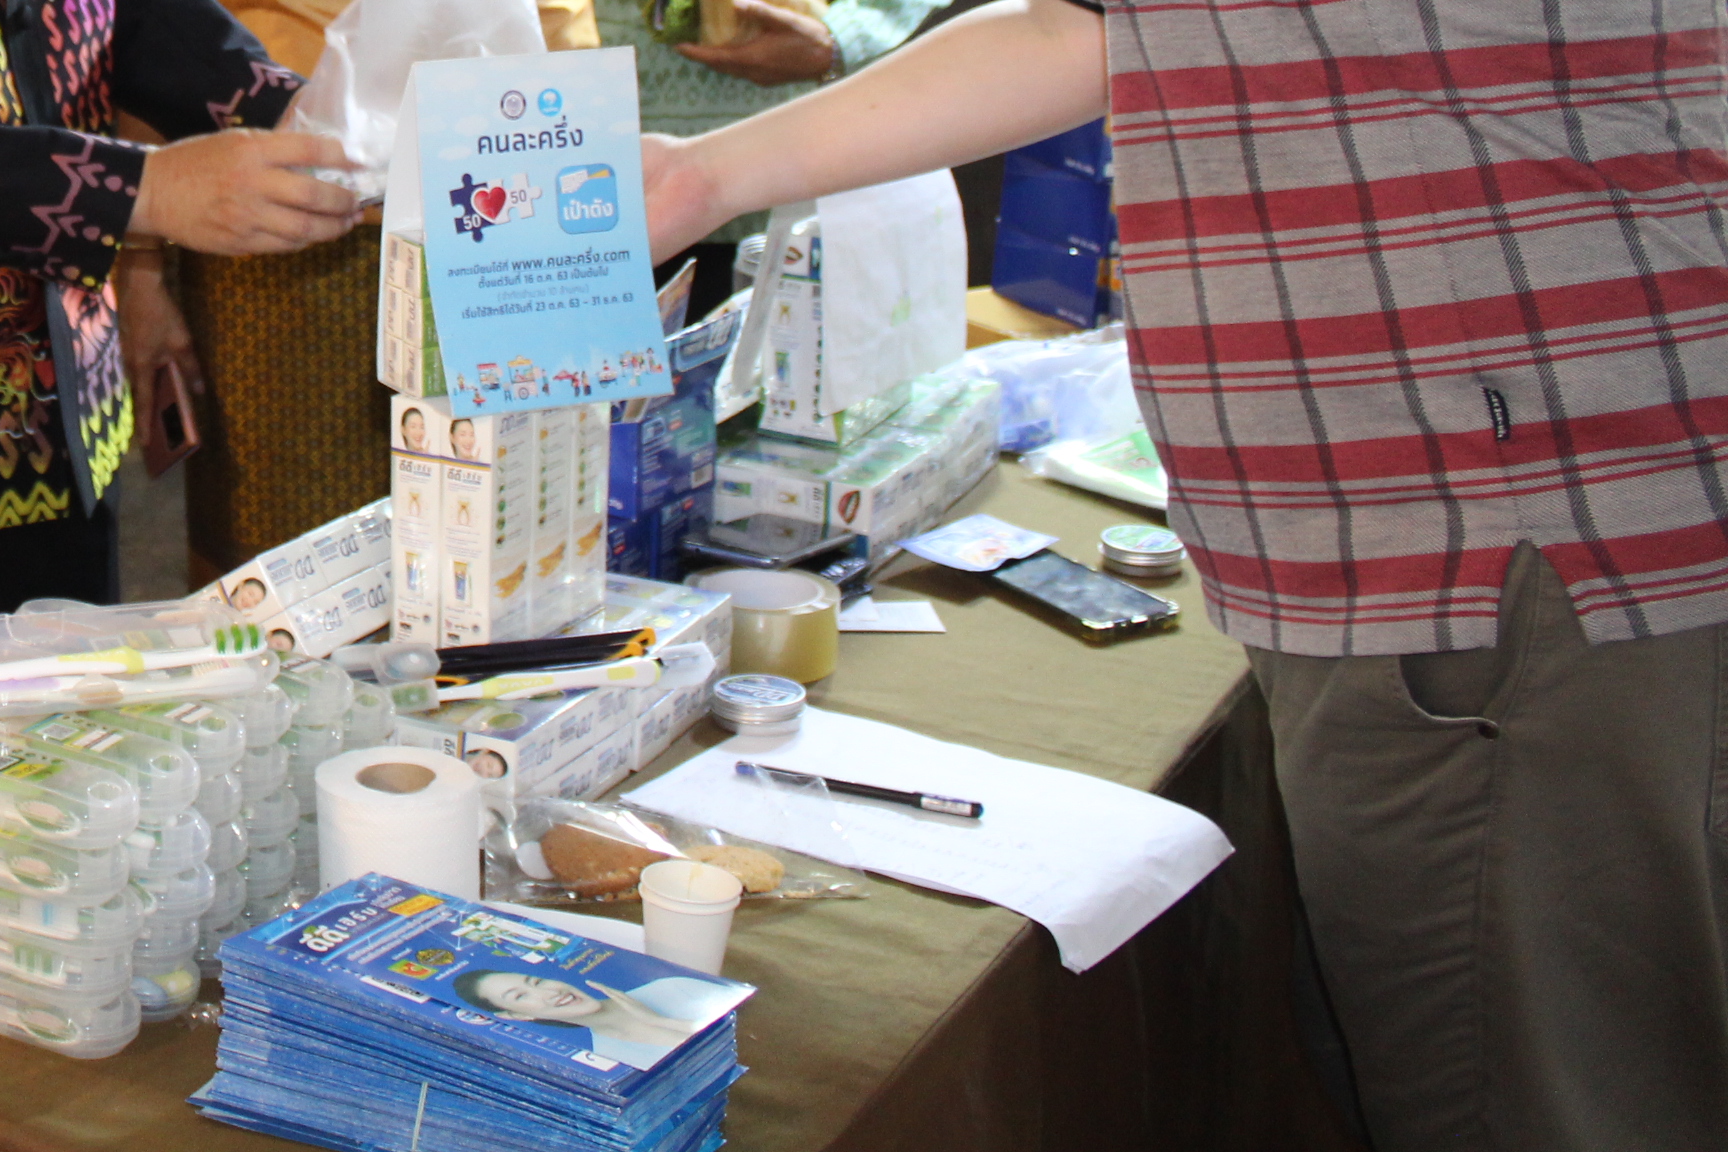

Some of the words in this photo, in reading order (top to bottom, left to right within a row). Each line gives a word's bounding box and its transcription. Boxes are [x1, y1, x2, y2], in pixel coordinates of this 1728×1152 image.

[478, 115, 584, 155] คนละครึ่ง
[510, 189, 527, 204] 50
[463, 215, 482, 230] 50
[557, 271, 568, 281] 63
[535, 302, 545, 311] 23
[569, 298, 580, 309] 63
[623, 292, 634, 303] 63
